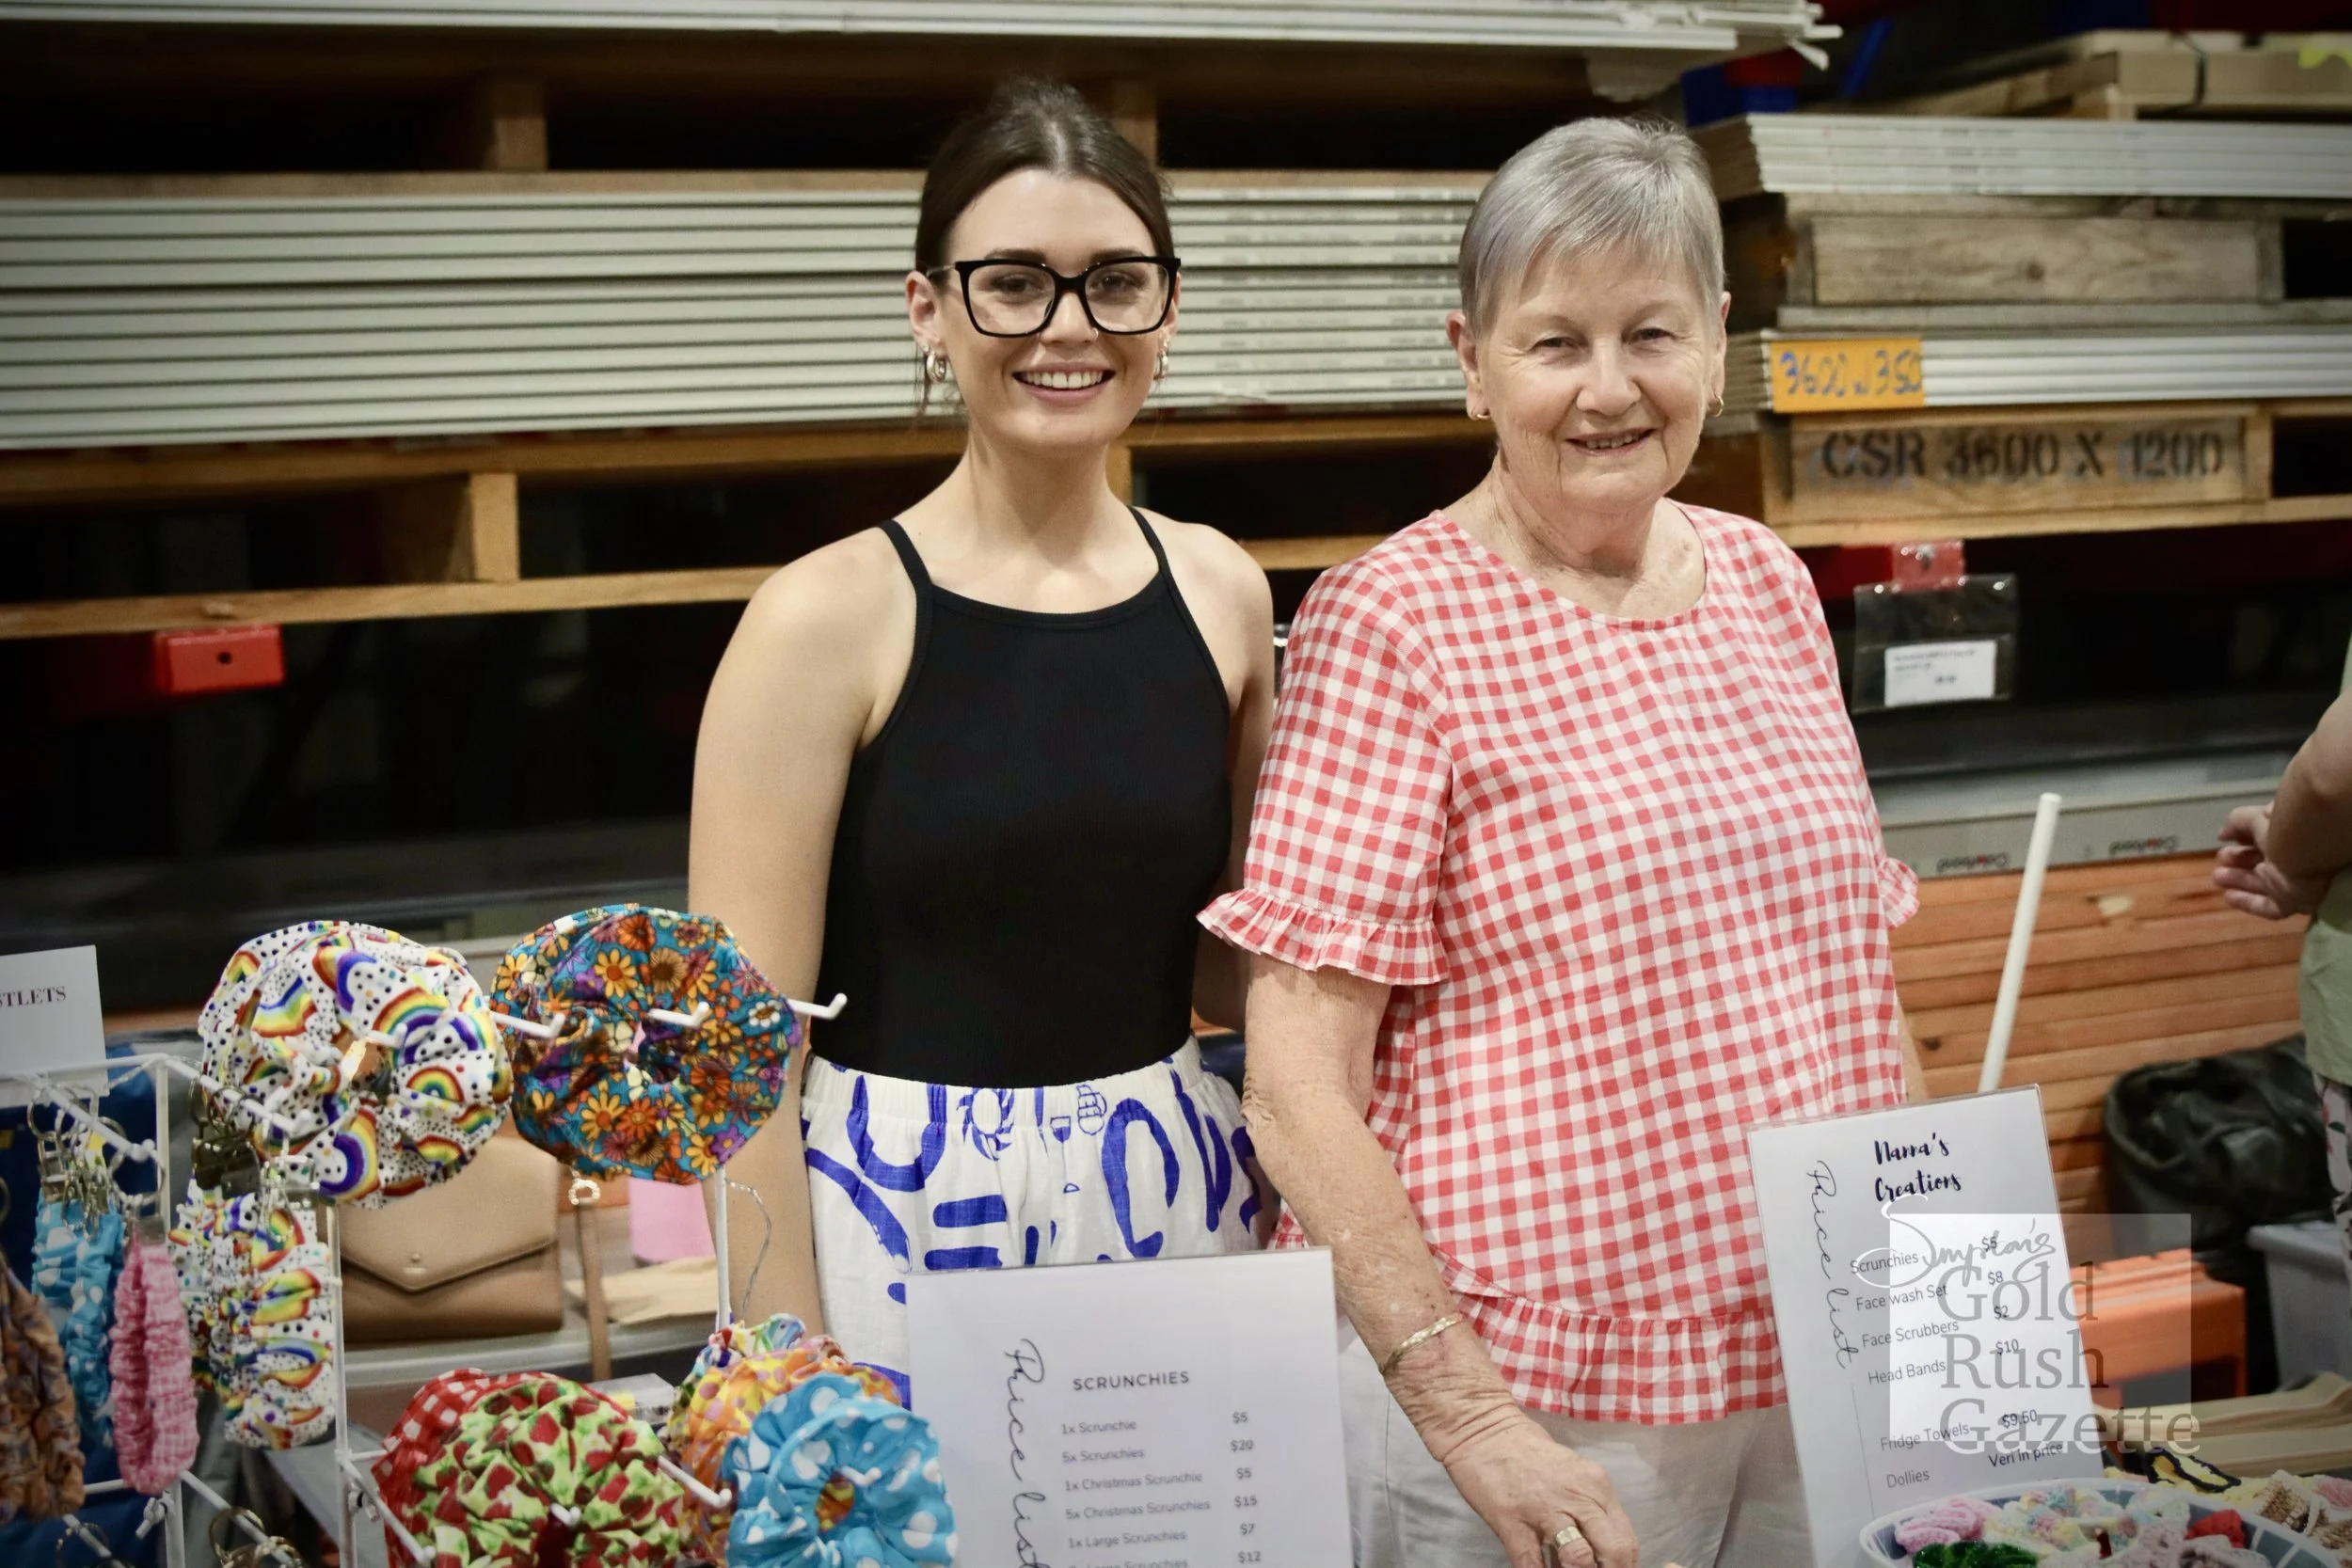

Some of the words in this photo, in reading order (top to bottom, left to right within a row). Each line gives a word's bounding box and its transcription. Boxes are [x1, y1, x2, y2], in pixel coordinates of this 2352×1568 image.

[1822, 429, 1926, 479] CSR
[1942, 429, 2060, 479] 3600
[2130, 431, 2225, 479] 1200
[0, 986, 67, 1007] TLETS
[1875, 1168, 1962, 1202] Creations
[1807, 1160, 1837, 1280] Price
[1826, 1288, 1859, 1369] list
[1851, 1252, 1919, 1275] Scrunchies
[1987, 1270, 2004, 1286] $8
[1856, 1296, 1886, 1311] Face
[1889, 1288, 1924, 1306] wash
[1927, 1283, 1947, 1299] Set
[1994, 1305, 2010, 1321] $2
[1862, 1333, 1892, 1348] Face
[1895, 1320, 1960, 1342] Scrubbers
[1995, 1338, 2020, 1356] $10
[1072, 1370, 1190, 1391] SCRUNCHIES
[1867, 1367, 1903, 1386] Head
[1906, 1359, 1947, 1379] Bands
[1004, 1338, 1045, 1482] Price
[1232, 1410, 1248, 1424] $5
[2001, 1408, 2039, 1430] $9.50
[1078, 1418, 1137, 1434] Scrunchie
[1230, 1438, 1254, 1452] $20
[1881, 1434, 1921, 1452] Fridge
[1923, 1422, 1970, 1441] Towels
[1079, 1447, 1146, 1463] Scrunchies
[2018, 1448, 2030, 1463] in
[2033, 1442, 2063, 1463] price
[1082, 1476, 1142, 1491] Christmas
[1145, 1470, 1203, 1486] Scrunchie
[1236, 1466, 1252, 1481] $5
[1885, 1469, 1931, 1489] Dollies
[1083, 1504, 1144, 1520] Christmas
[1146, 1498, 1212, 1514] Scrunchies
[1233, 1494, 1259, 1509] $15
[1239, 1521, 1256, 1536] $7
[1085, 1534, 1120, 1550] Large
[1122, 1529, 1187, 1544] Scrunchies
[1237, 1549, 1262, 1564] $12
